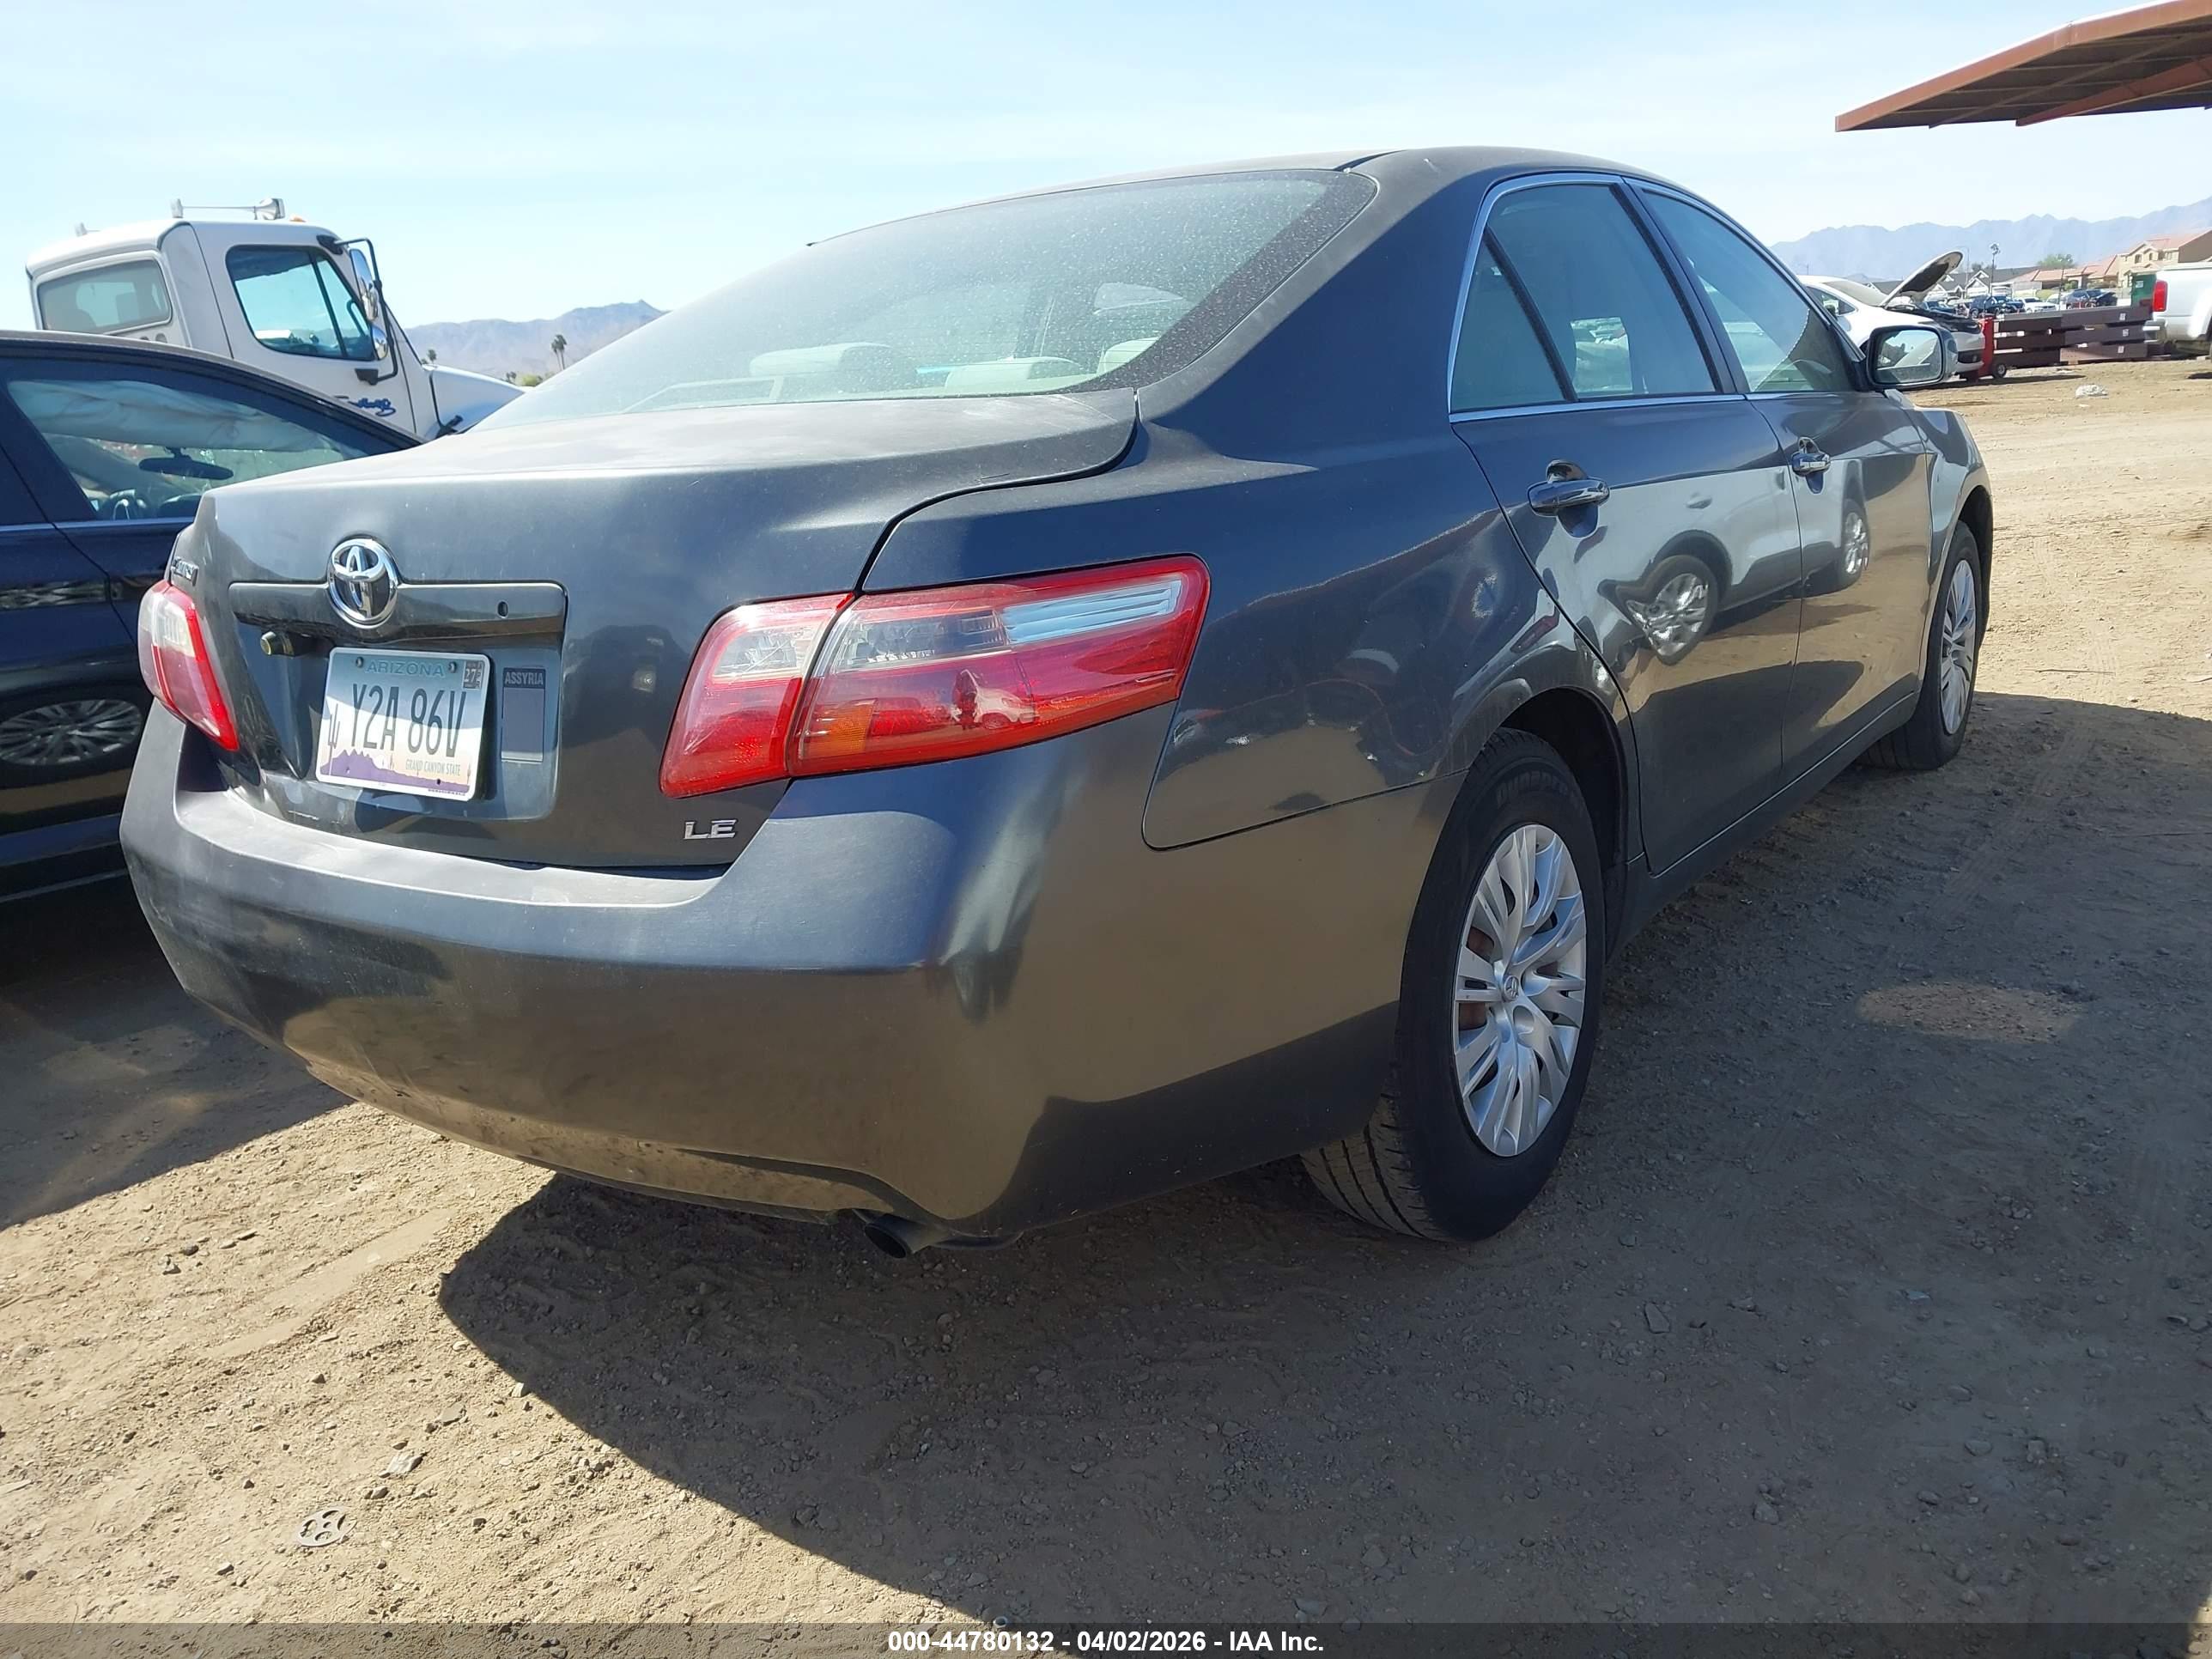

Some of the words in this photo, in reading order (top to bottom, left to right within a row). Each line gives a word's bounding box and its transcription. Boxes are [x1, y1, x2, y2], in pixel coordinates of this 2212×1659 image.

[365, 659, 446, 678] ARIZONA
[504, 672, 544, 685] ASSYRIA
[351, 683, 400, 751] Y2A
[408, 688, 467, 757] 86V
[405, 759, 423, 771] GRAND
[424, 761, 446, 774] CANYON
[446, 763, 461, 776] STATE
[684, 819, 737, 840] LE
